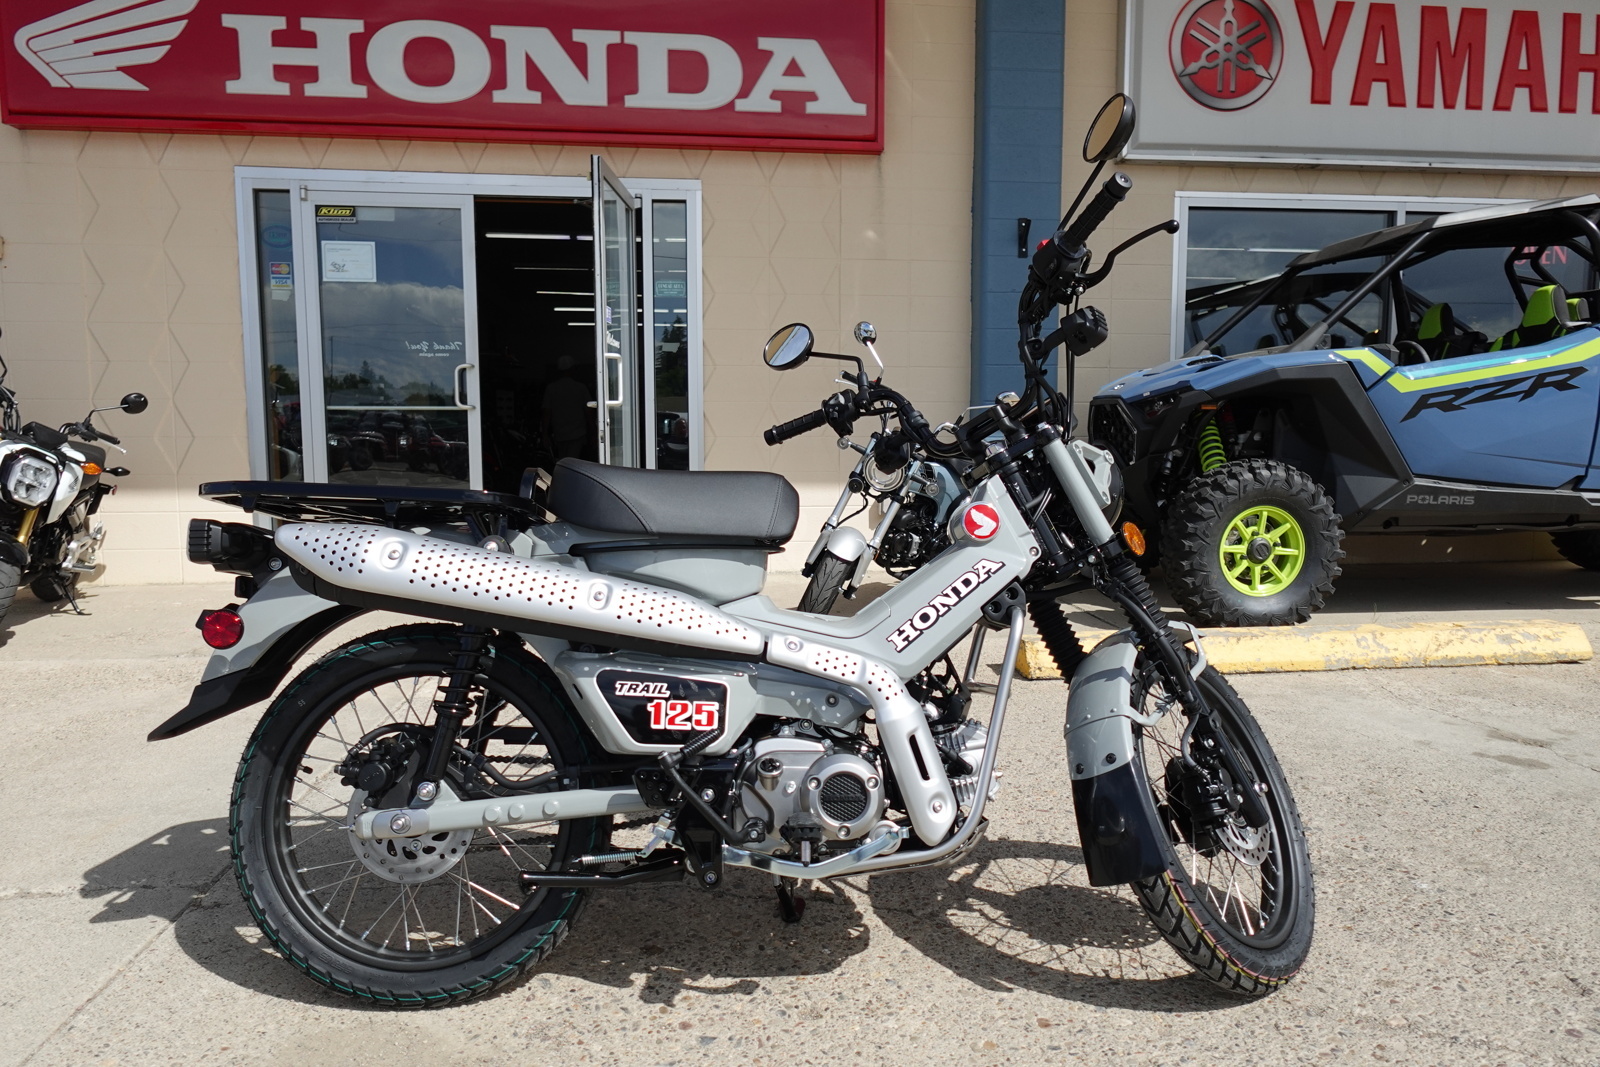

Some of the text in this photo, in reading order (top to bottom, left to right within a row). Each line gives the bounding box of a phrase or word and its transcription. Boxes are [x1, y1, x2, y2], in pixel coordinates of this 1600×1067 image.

[221, 13, 867, 116] HONDA
[320, 207, 350, 215] Klim
[1399, 366, 1589, 424] RZR
[1406, 494, 1475, 505] POLARIS
[886, 558, 1006, 653] HONDA
[615, 681, 671, 698] TRAIL
[647, 699, 719, 730] 125
